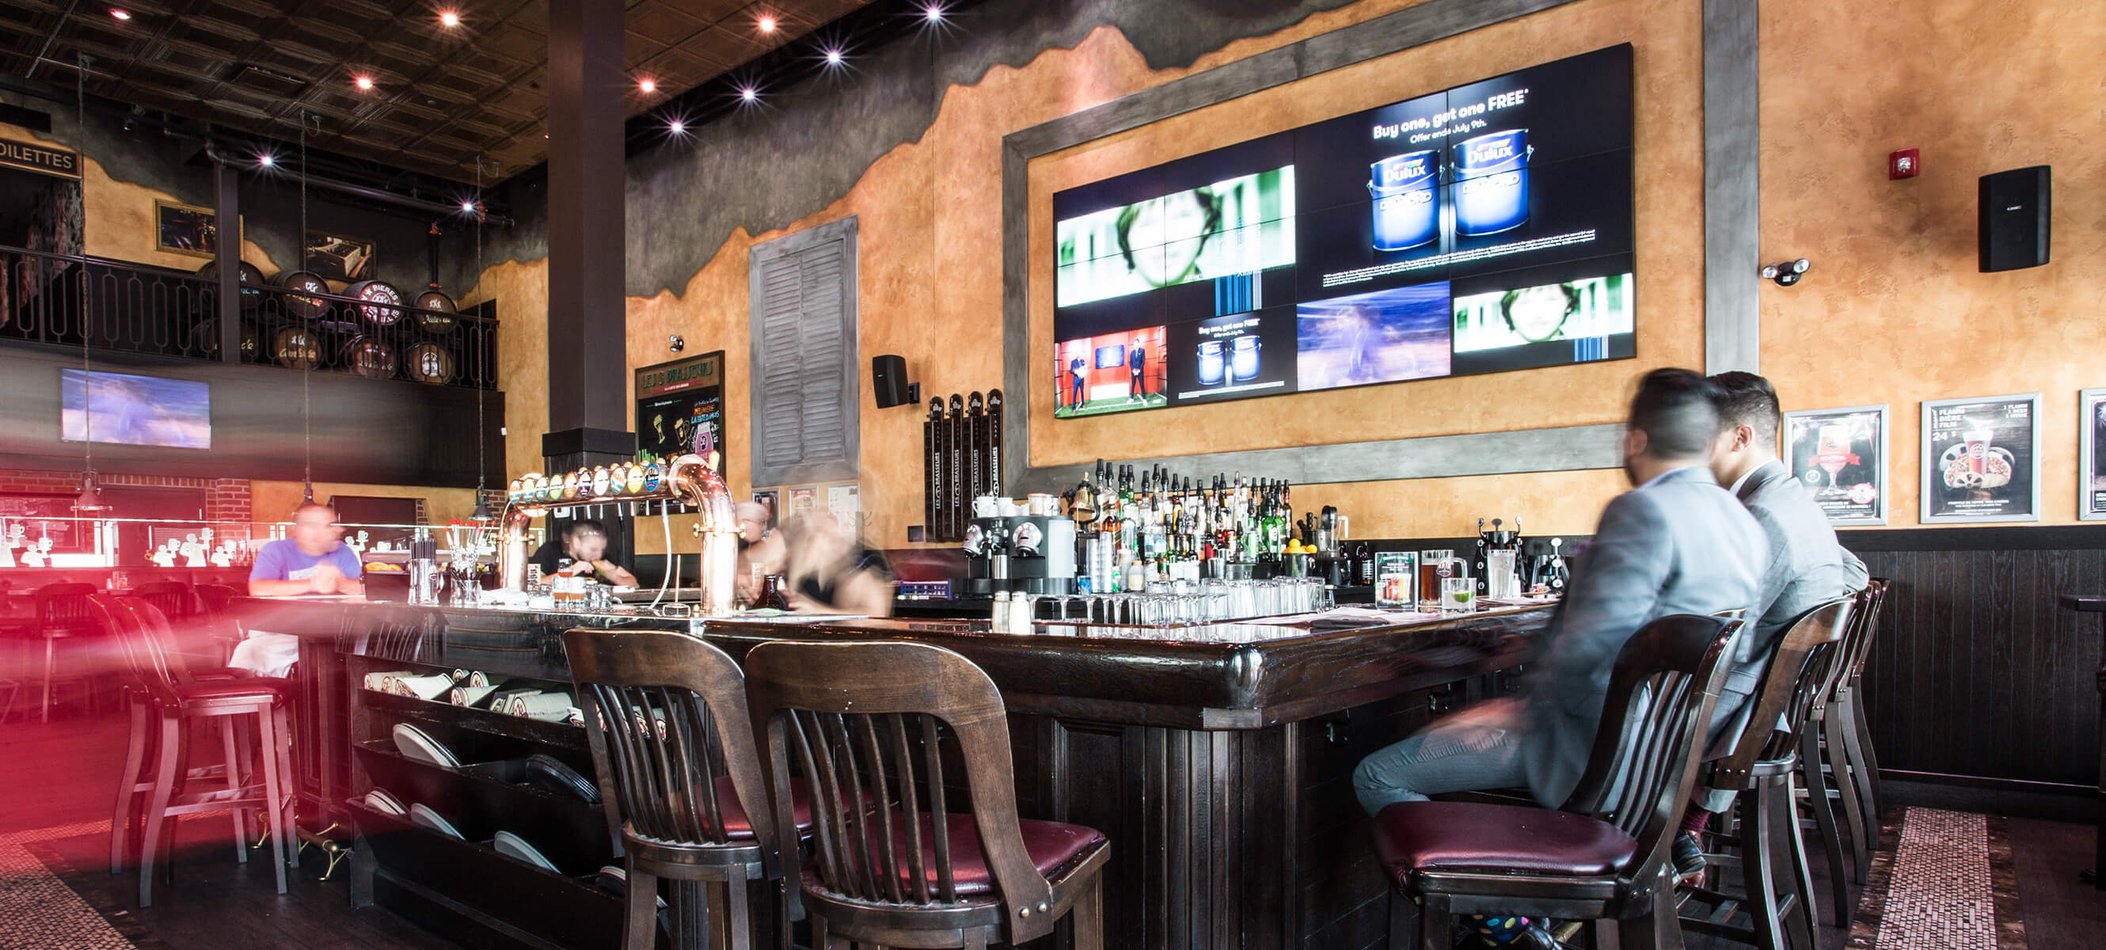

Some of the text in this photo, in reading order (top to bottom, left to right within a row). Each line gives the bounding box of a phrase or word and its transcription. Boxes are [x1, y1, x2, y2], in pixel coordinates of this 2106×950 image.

[1373, 124, 1399, 139] Buy
[1400, 117, 1431, 132] one,
[1432, 107, 1457, 128] get
[1458, 102, 1486, 117] one
[1410, 118, 1487, 144] Offer ends July 9th.
[1467, 145, 1513, 164] Dulux
[1384, 163, 1426, 181] Dulux
[1932, 432, 1948, 441] 24
